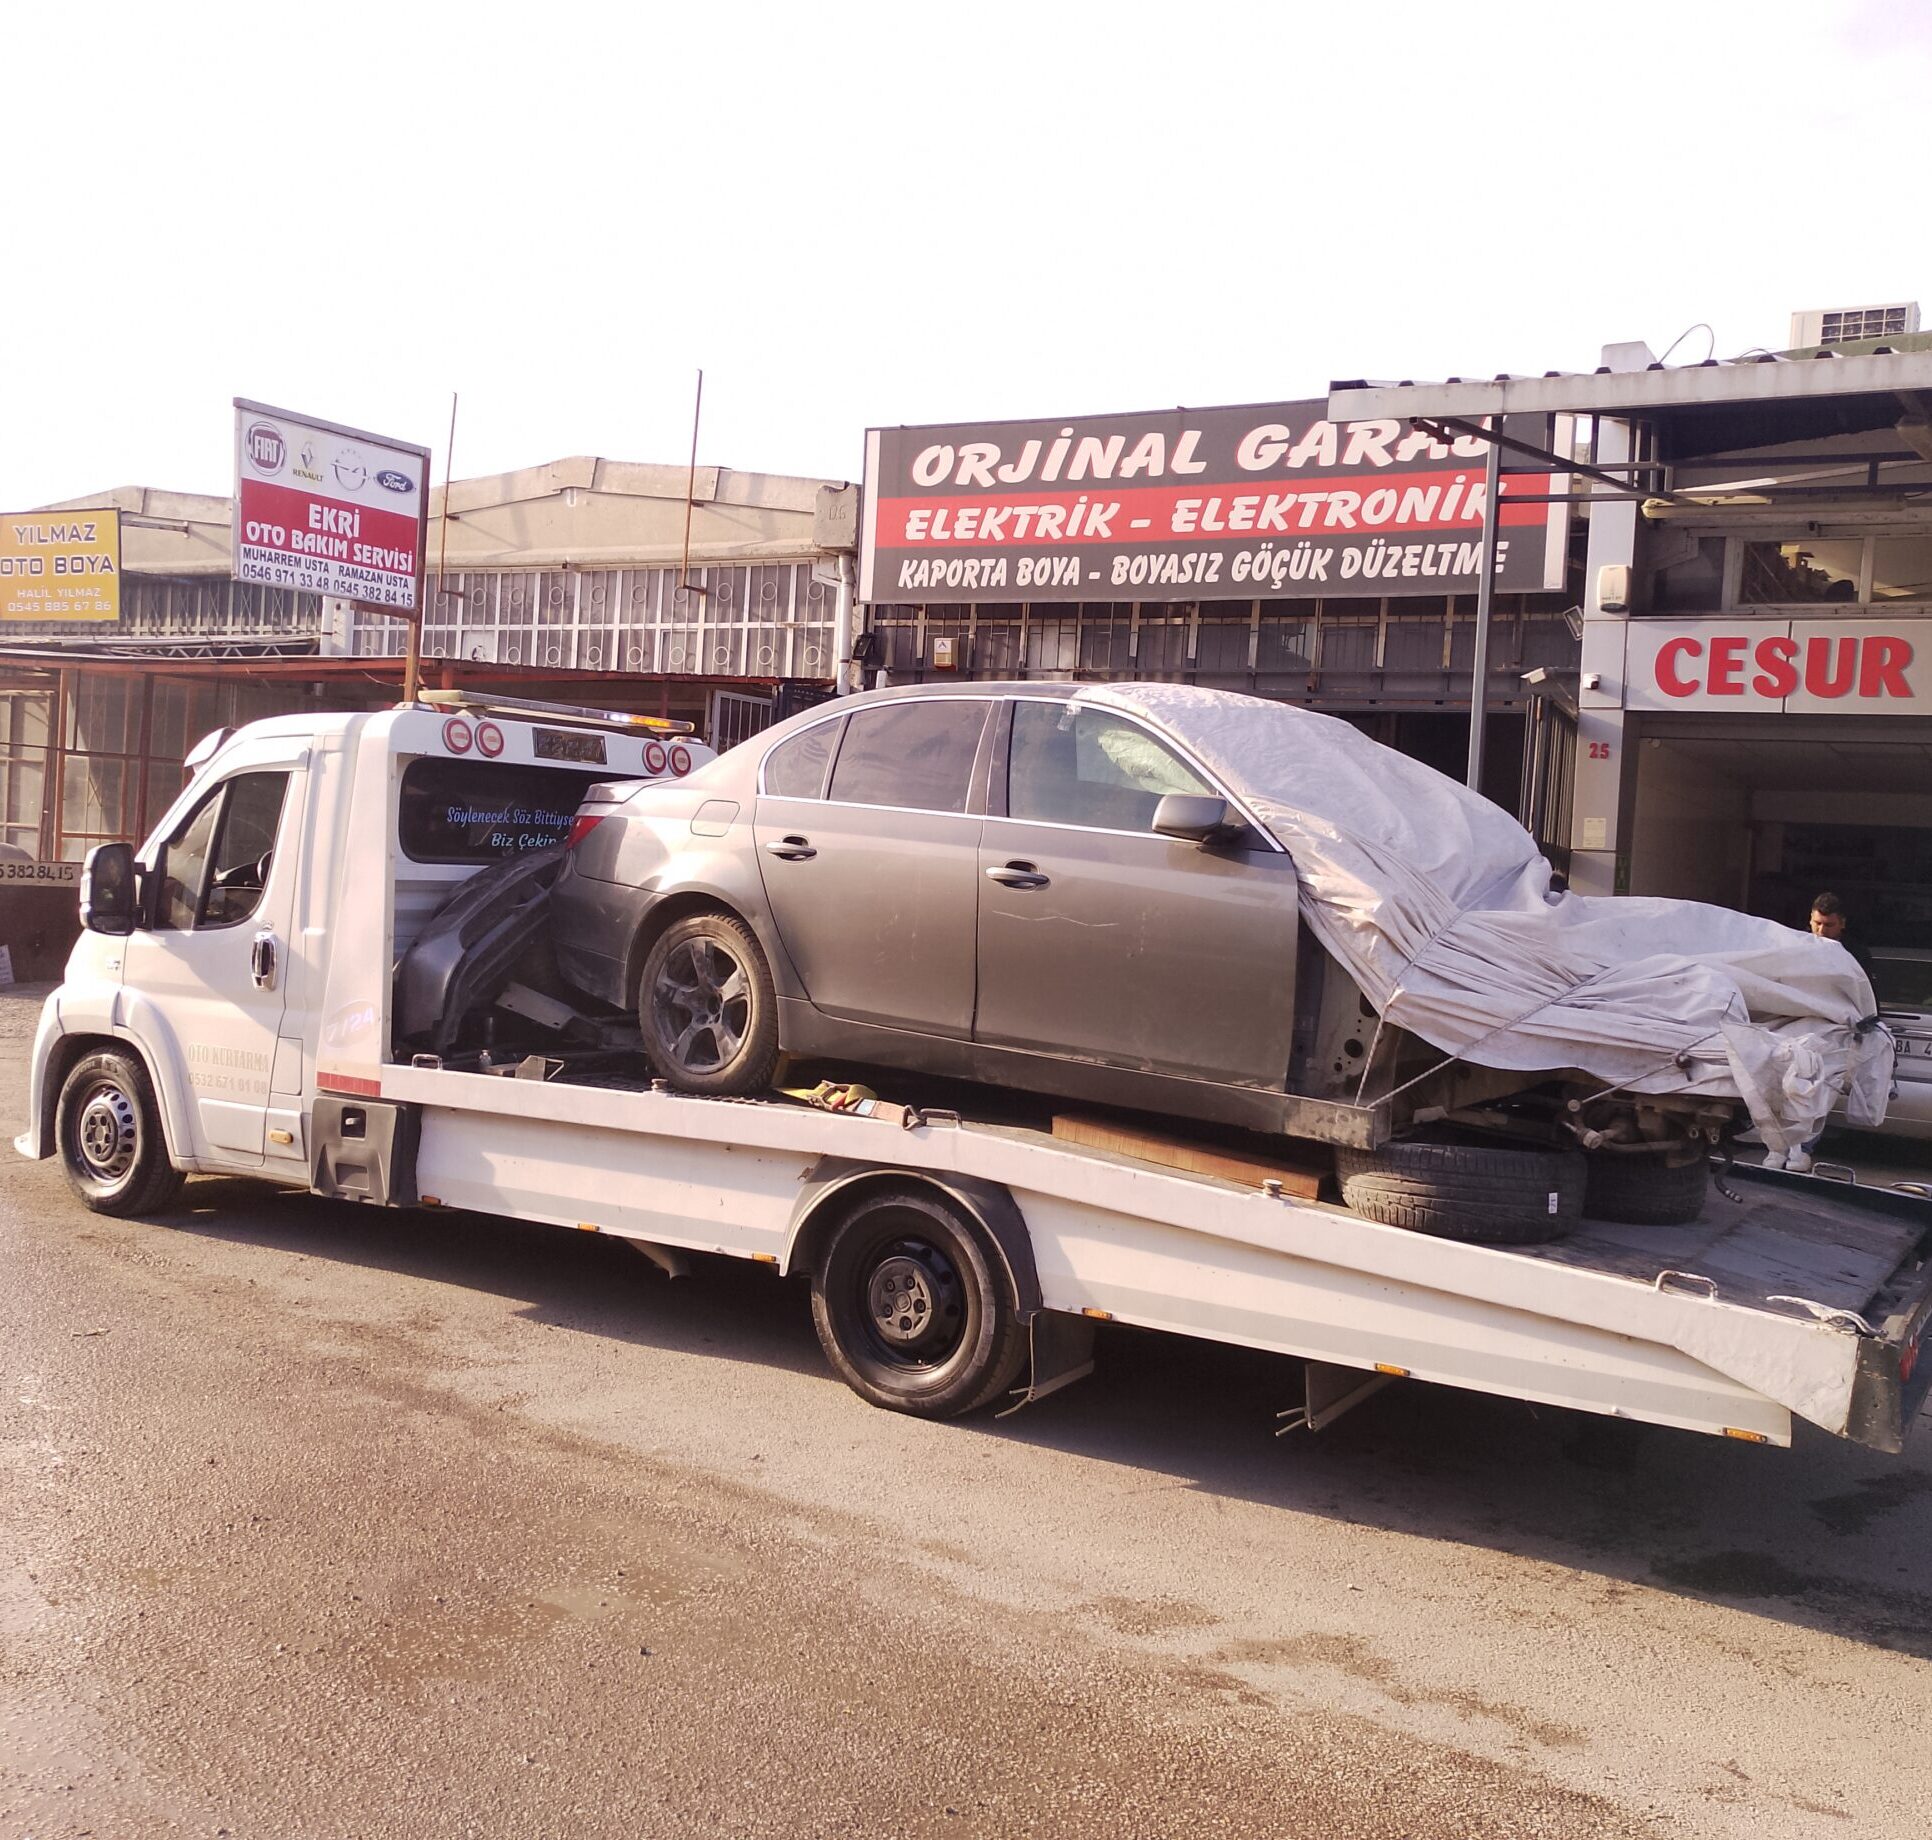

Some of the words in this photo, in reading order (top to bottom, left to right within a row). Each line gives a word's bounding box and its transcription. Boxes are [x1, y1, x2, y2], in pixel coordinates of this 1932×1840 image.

[254, 435, 280, 463] FIAT
[911, 427, 1207, 488] ORJİNAL
[292, 467, 324, 483] RENAULT
[383, 473, 408, 491] Ford
[308, 503, 360, 538] EKRİ
[905, 495, 1120, 541] ELEKTRİK
[1171, 474, 1507, 533] ELEKTRONİK
[13, 523, 97, 545] YILMAZ
[246, 521, 286, 546] OTO
[291, 529, 348, 559] BAKIM
[353, 542, 413, 573] SERVİSİ
[0, 557, 44, 576] OTO
[54, 554, 116, 575] BOYA
[242, 546, 302, 569] MUHARREM
[304, 558, 330, 574] USTA
[338, 565, 383, 585] RAMAZAN
[386, 576, 409, 590] USTA
[898, 557, 1007, 590] KAPORTA
[1016, 556, 1080, 587] BOYA
[1110, 552, 1224, 586] BOYASIZ
[1231, 541, 1334, 590] GÖÇÜK
[1340, 538, 1510, 580] DÜZELTME
[17, 585, 52, 598] HALİL
[57, 587, 102, 598] YILMAZ
[242, 563, 272, 581] 0546
[275, 570, 295, 584] 971
[300, 574, 313, 588] 33
[316, 576, 329, 591] 48
[334, 580, 359, 596] 0545
[362, 585, 381, 600] 382
[384, 590, 397, 604] 84
[400, 593, 413, 607] 15
[8, 602, 40, 612] 0545
[74, 602, 89, 611] 67
[1654, 636, 1915, 699] CESUR
[1588, 742, 1610, 759] 25
[447, 806, 510, 828] Söylenecek
[513, 808, 531, 824] Söz
[492, 832, 514, 847] Biz
[188, 1044, 209, 1063] OTO
[212, 1046, 269, 1073] KURTARMA
